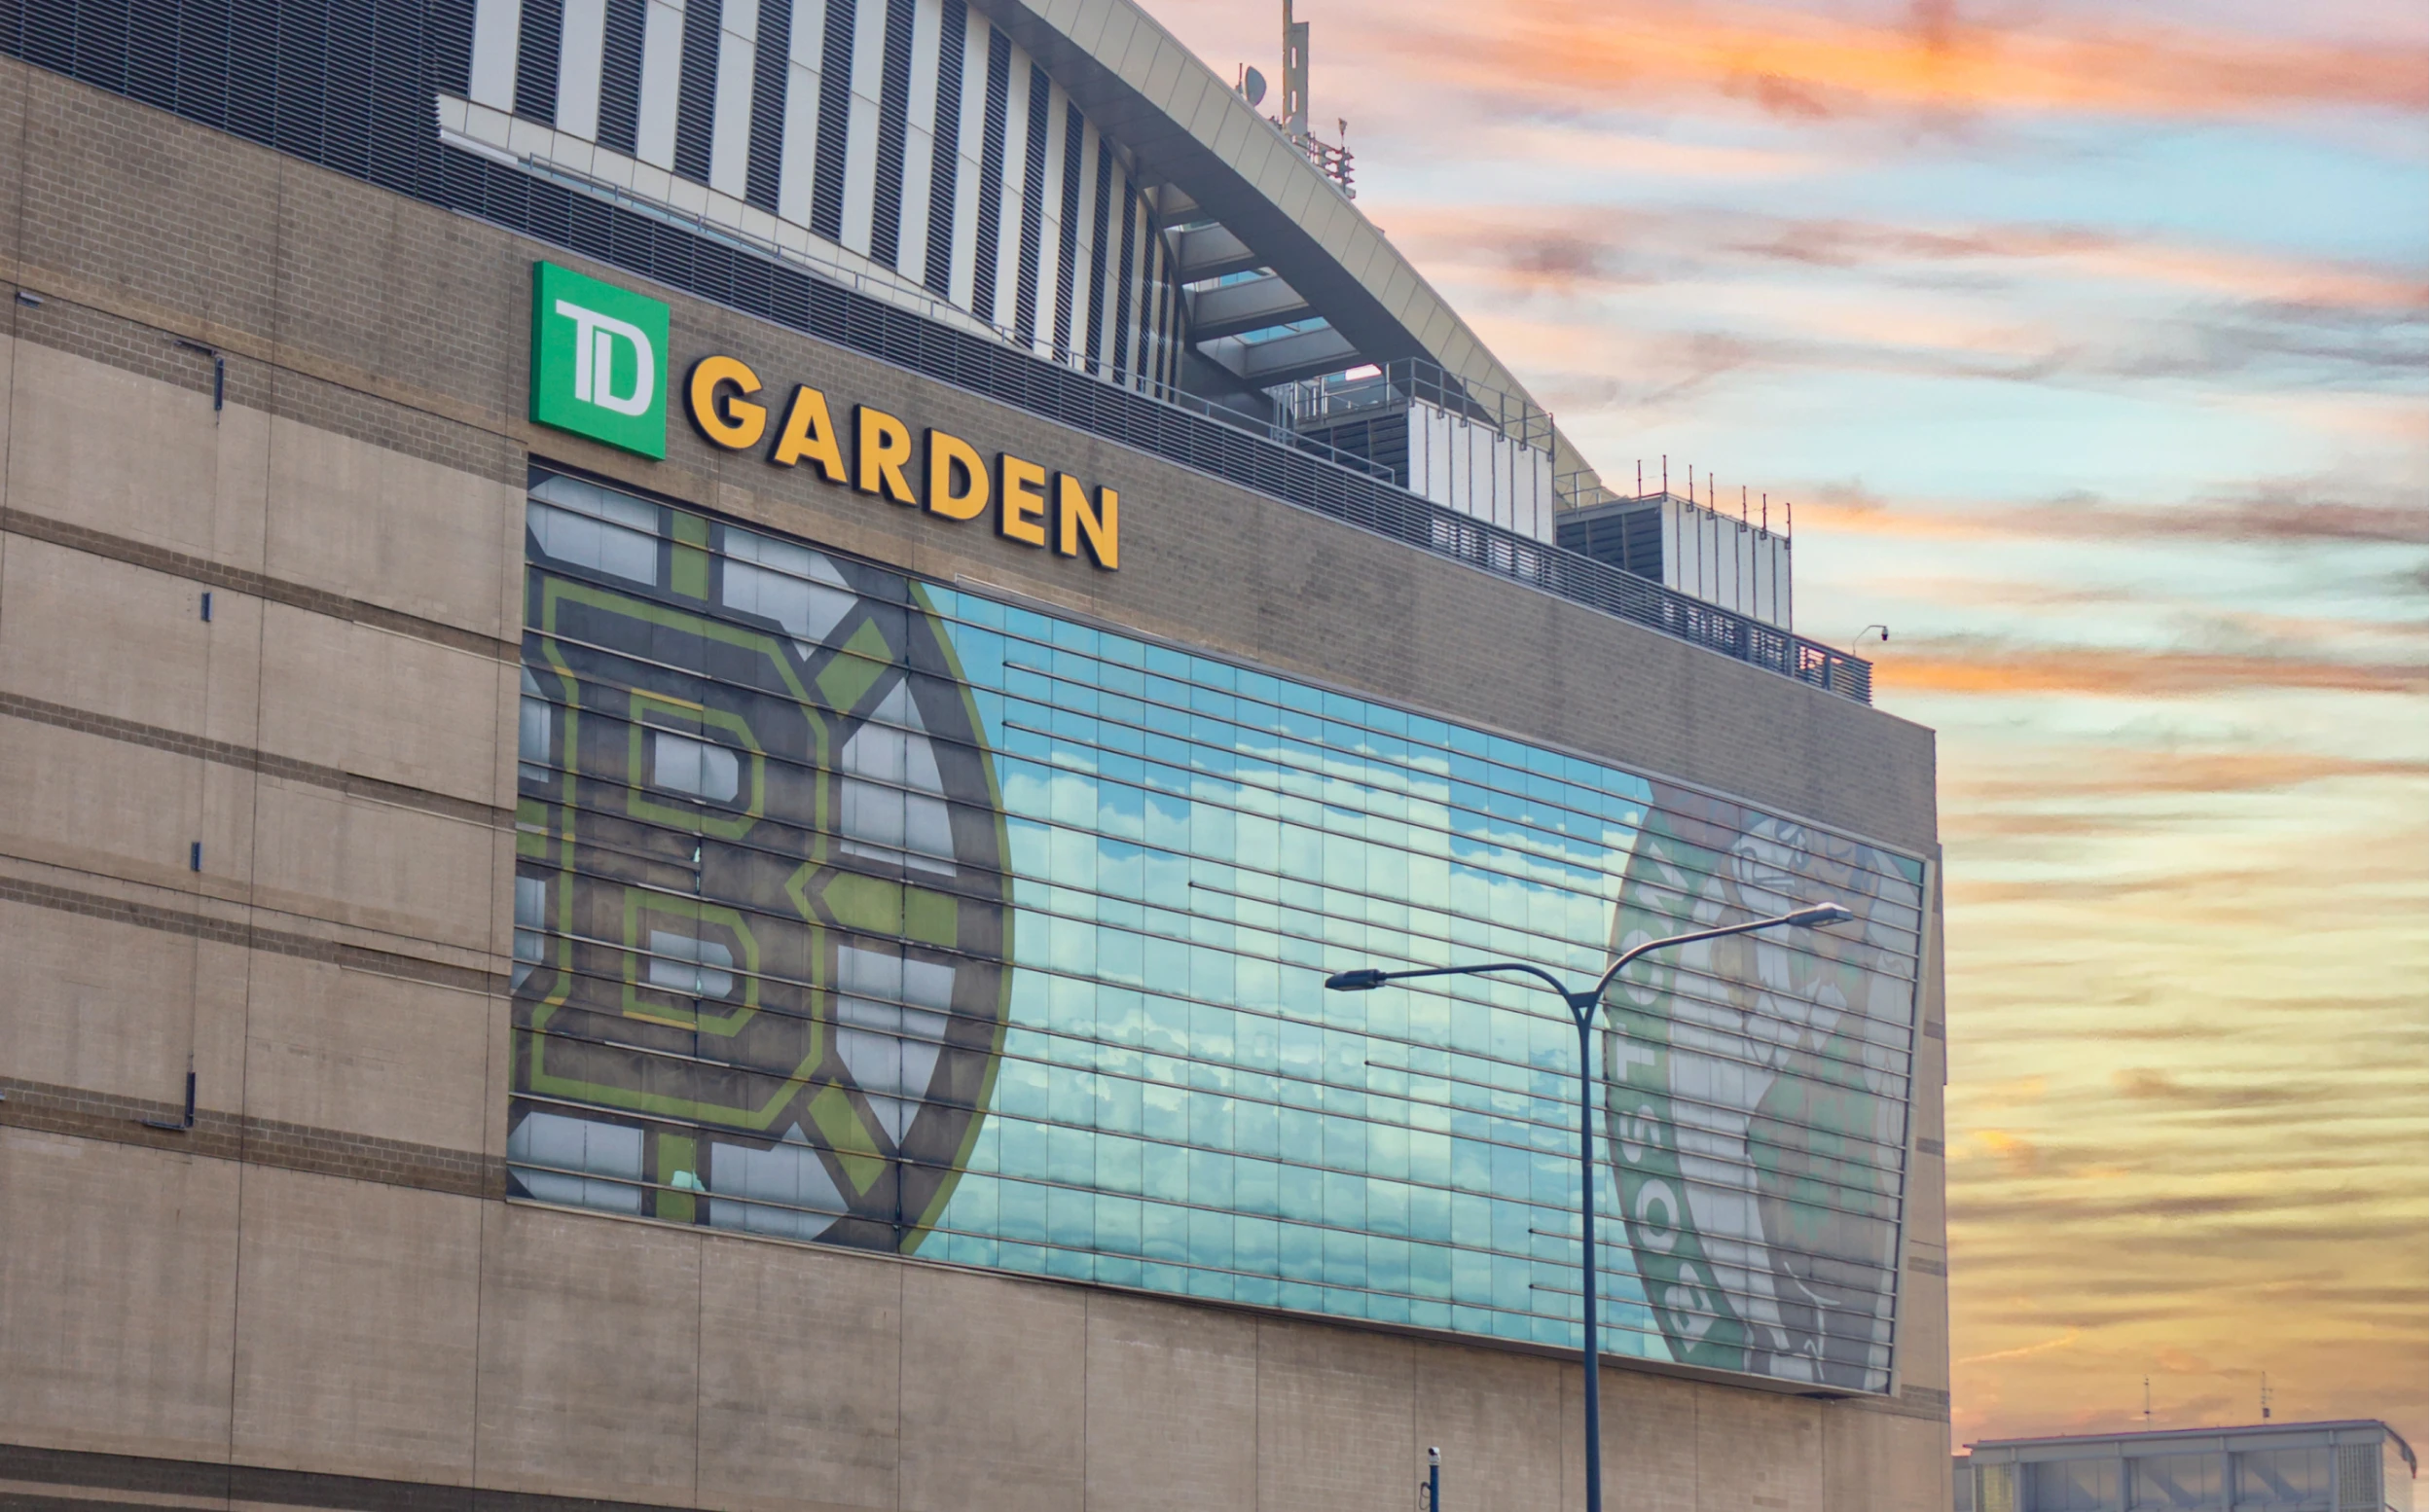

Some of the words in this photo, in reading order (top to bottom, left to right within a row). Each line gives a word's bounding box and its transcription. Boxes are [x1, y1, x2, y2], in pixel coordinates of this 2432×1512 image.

[555, 299, 654, 416] TD
[683, 355, 1119, 571] GARDEN
[531, 576, 829, 1132] B
[1615, 842, 1715, 1351] BOSTON
